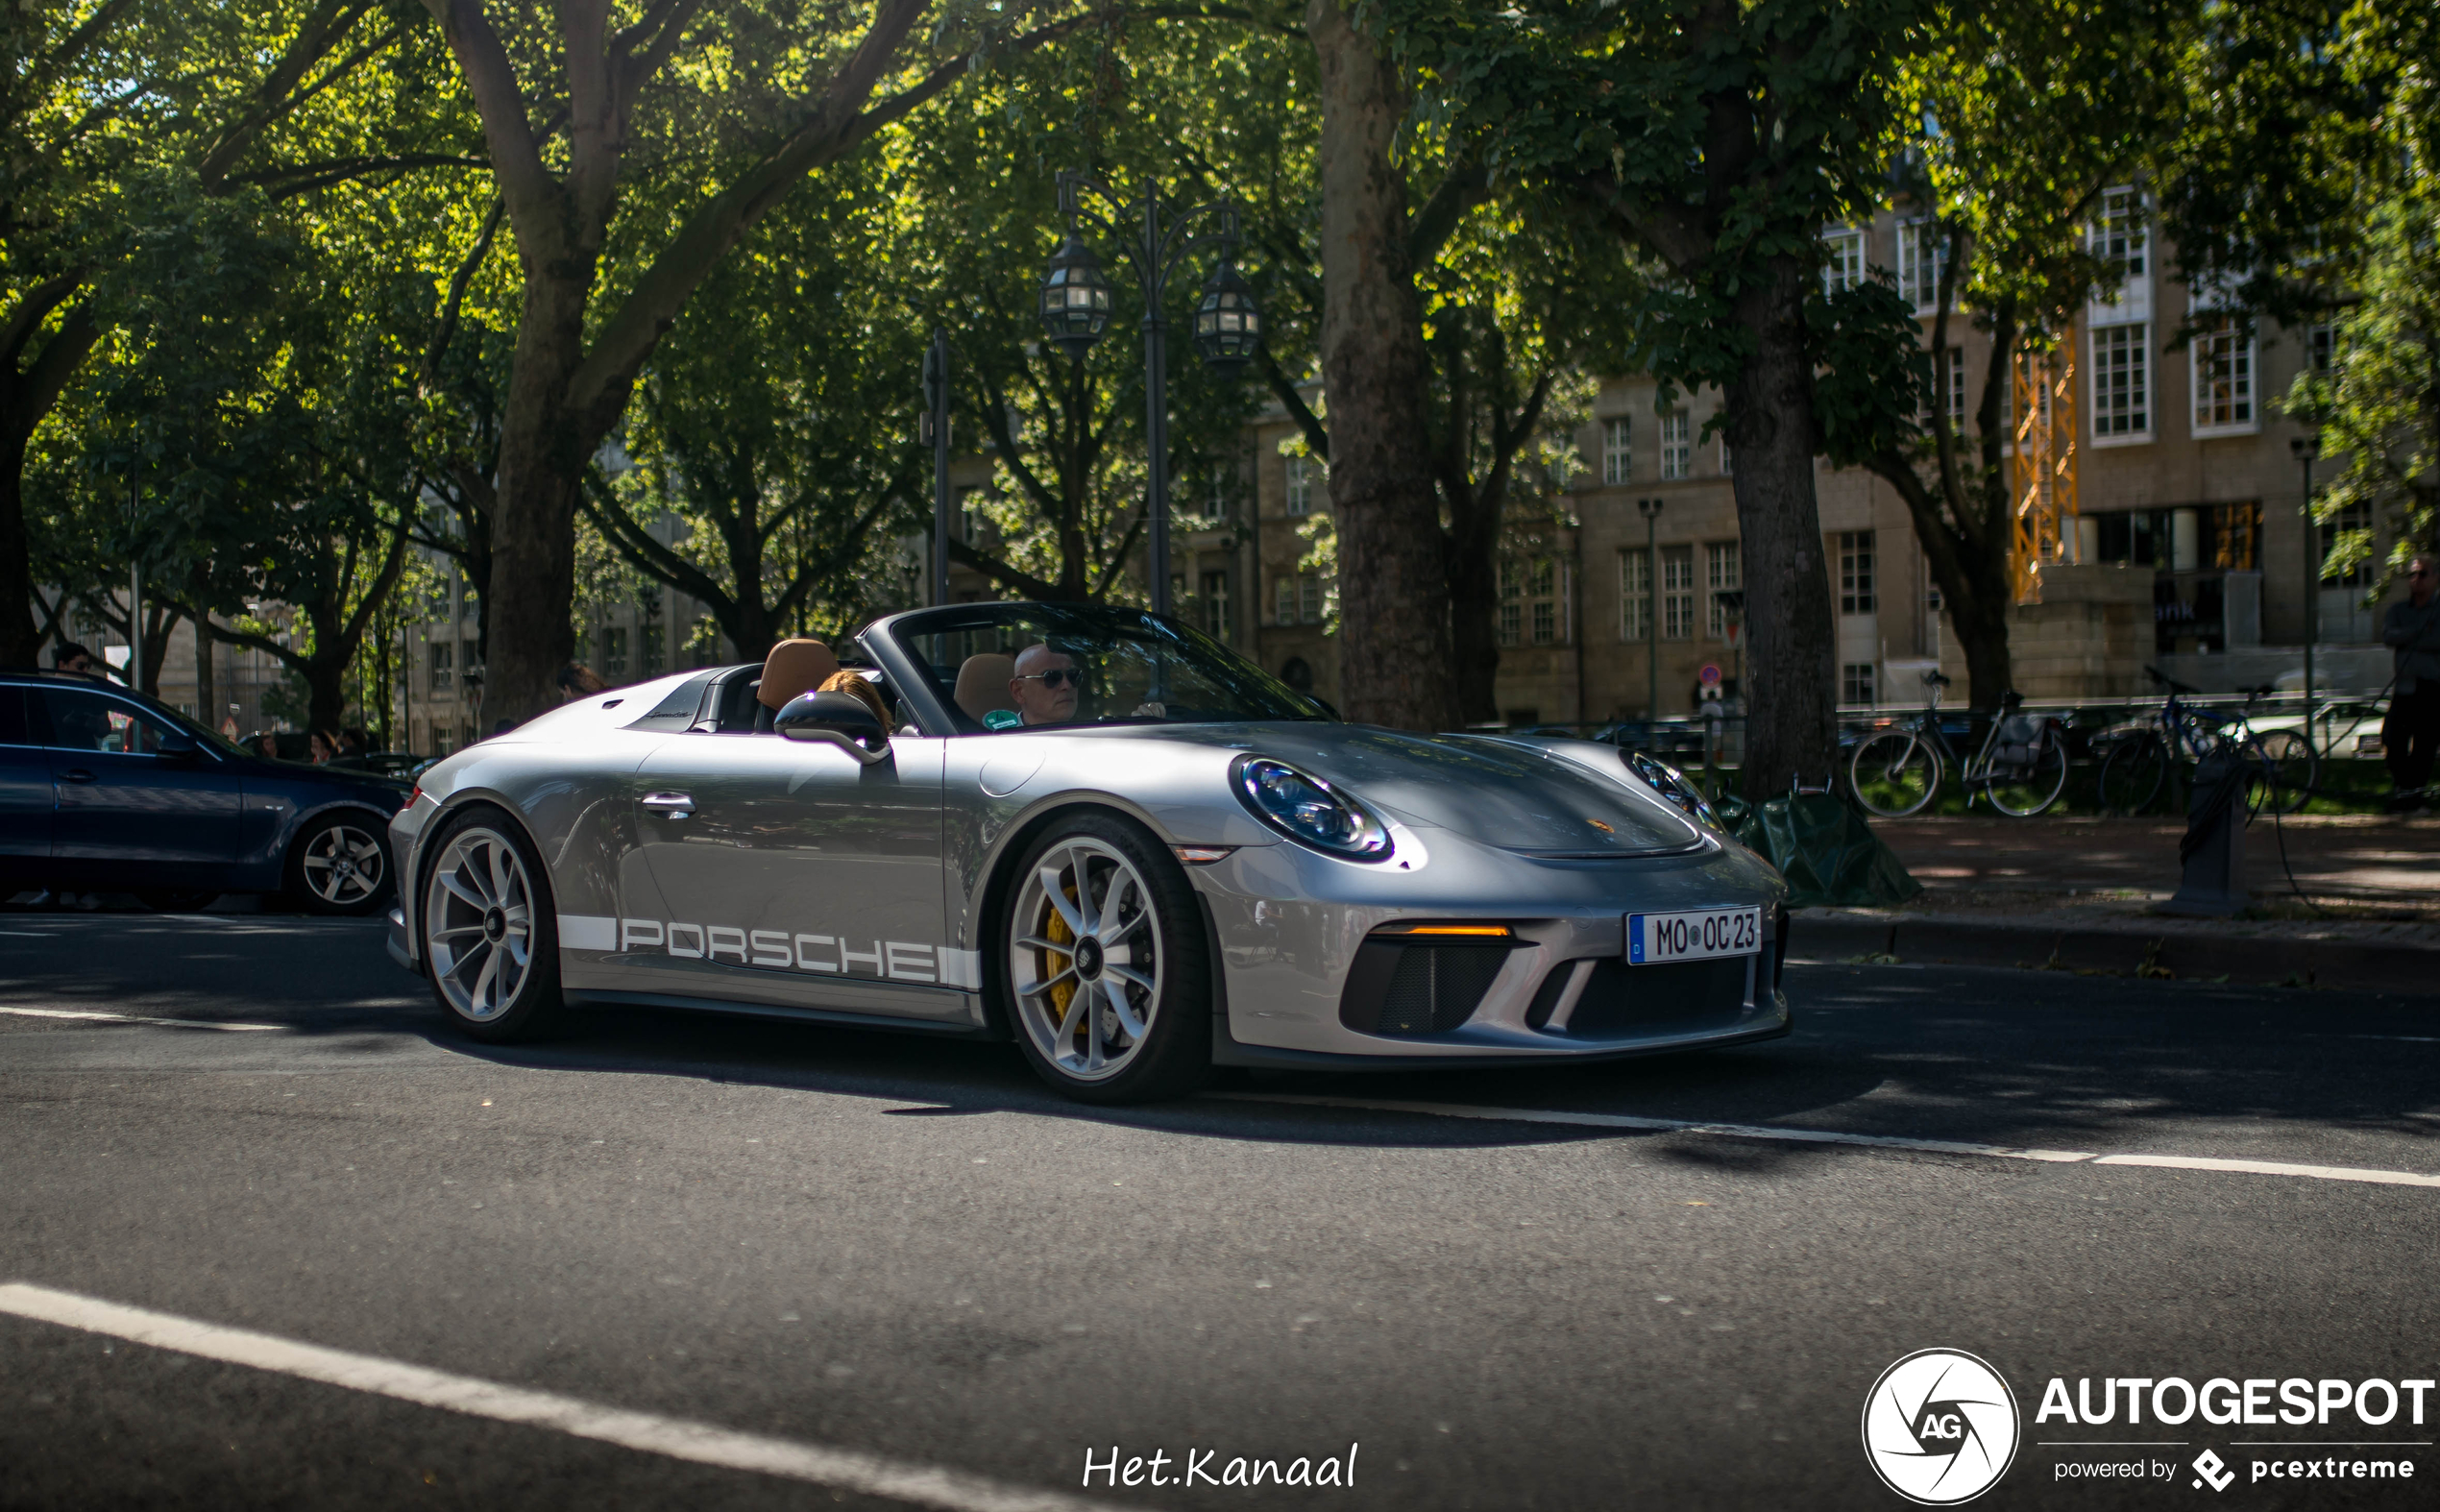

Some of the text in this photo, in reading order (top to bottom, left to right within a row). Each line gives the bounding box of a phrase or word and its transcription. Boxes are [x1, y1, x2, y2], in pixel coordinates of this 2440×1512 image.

[622, 918, 936, 982] PORSCHE
[1657, 918, 1688, 955] MO
[1734, 914, 1755, 949] 23
